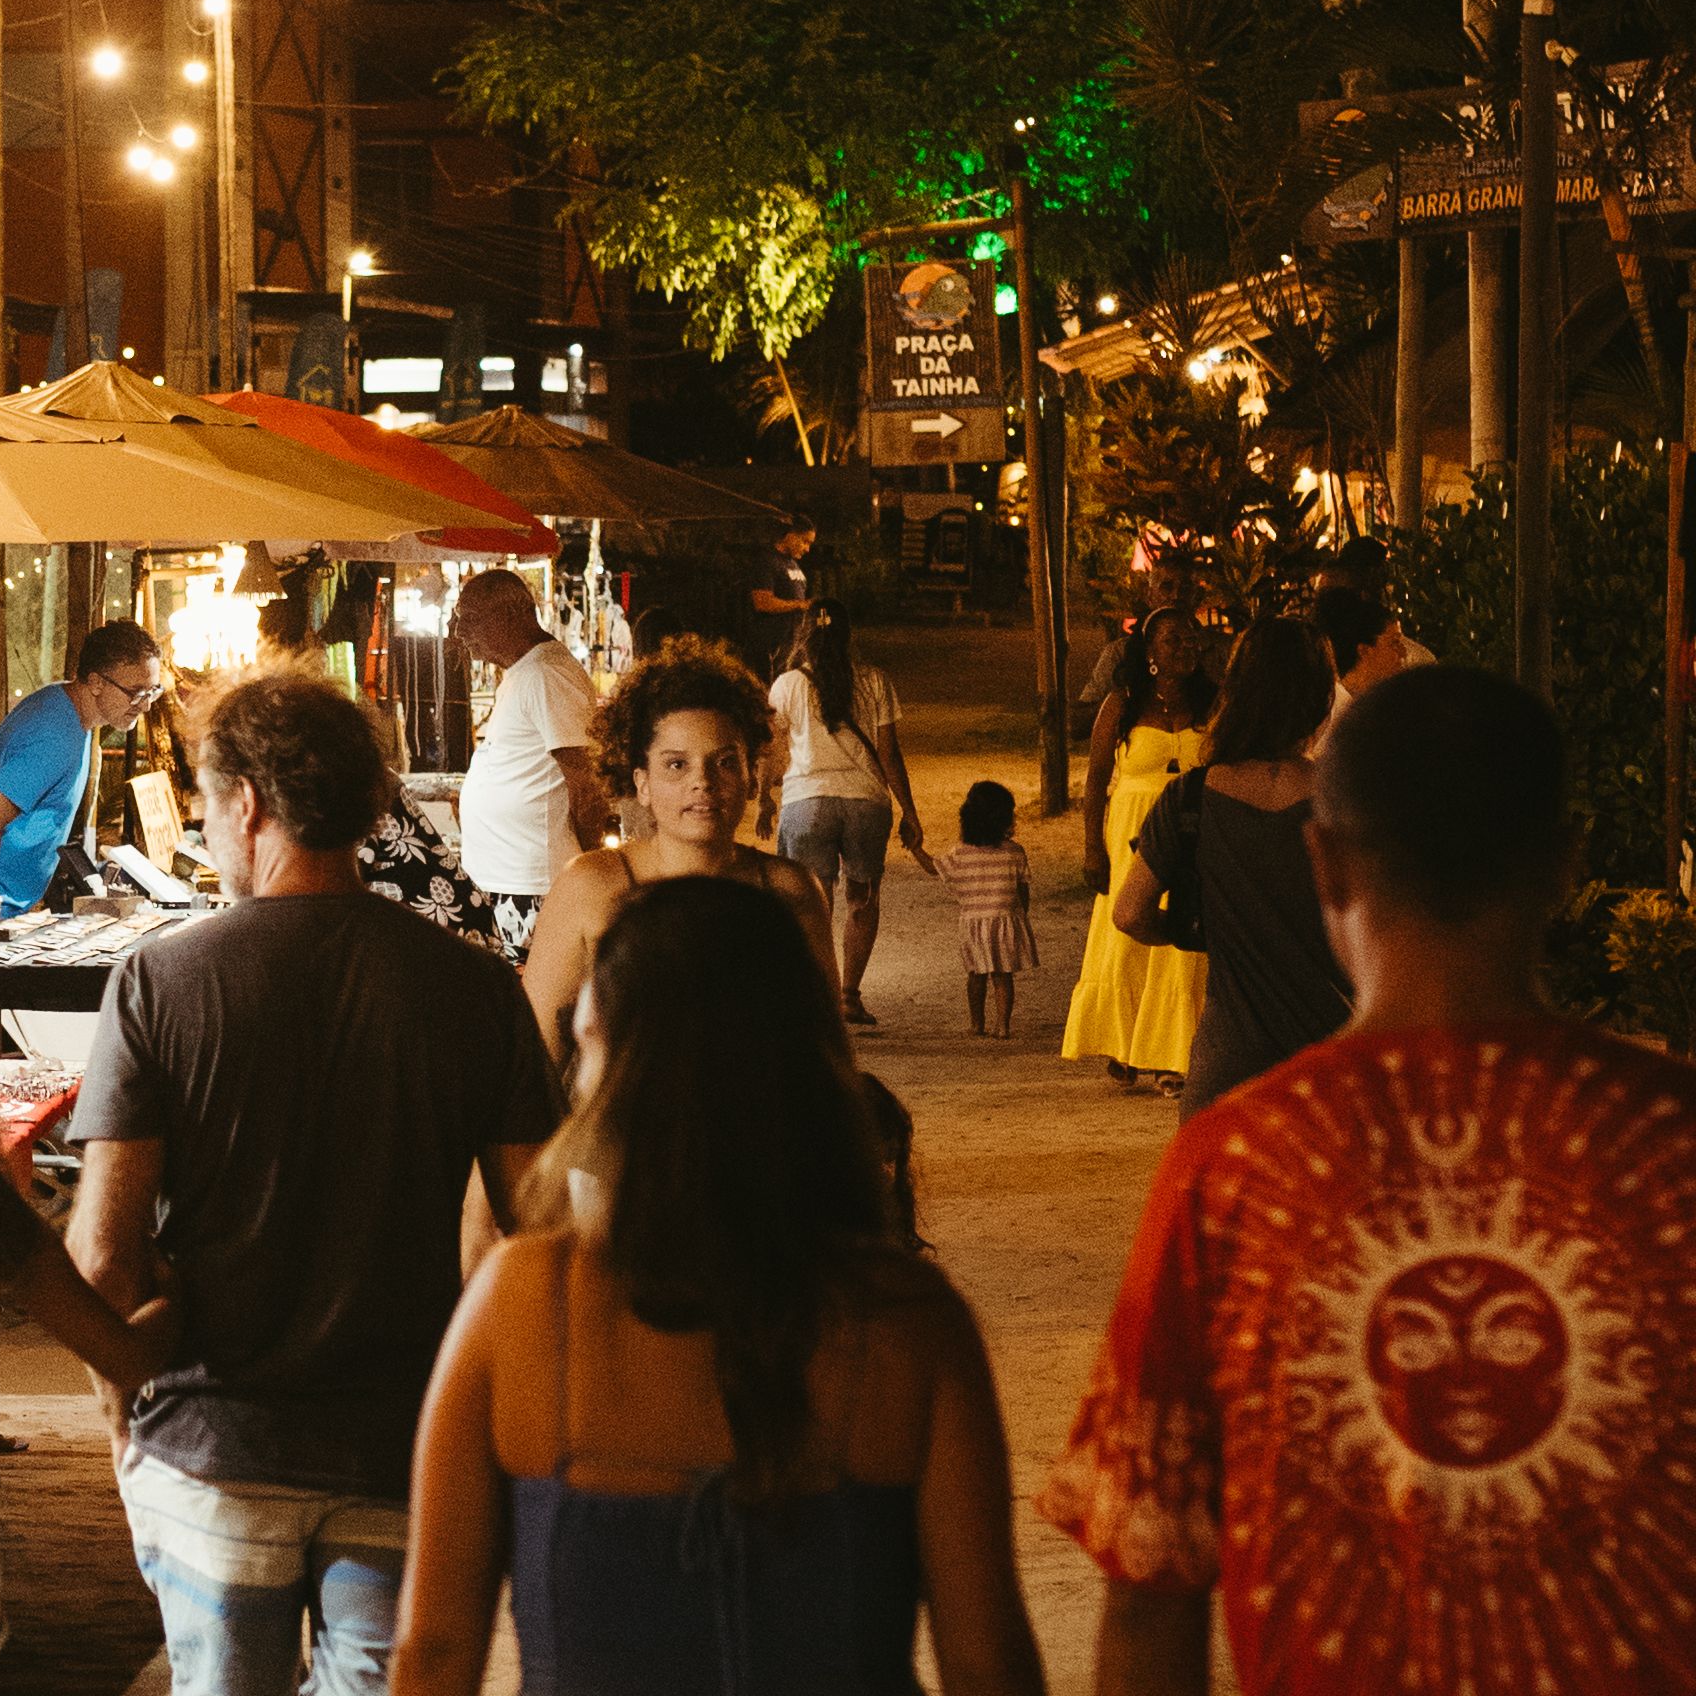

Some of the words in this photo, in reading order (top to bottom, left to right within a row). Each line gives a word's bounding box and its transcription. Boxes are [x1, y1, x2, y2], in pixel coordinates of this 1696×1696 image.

[1401, 191, 1462, 220] BARRA
[1467, 183, 1524, 212] GRAN
[895, 333, 975, 357] PRAÇA
[920, 355, 951, 375] DA
[891, 376, 981, 397] TAINHA
